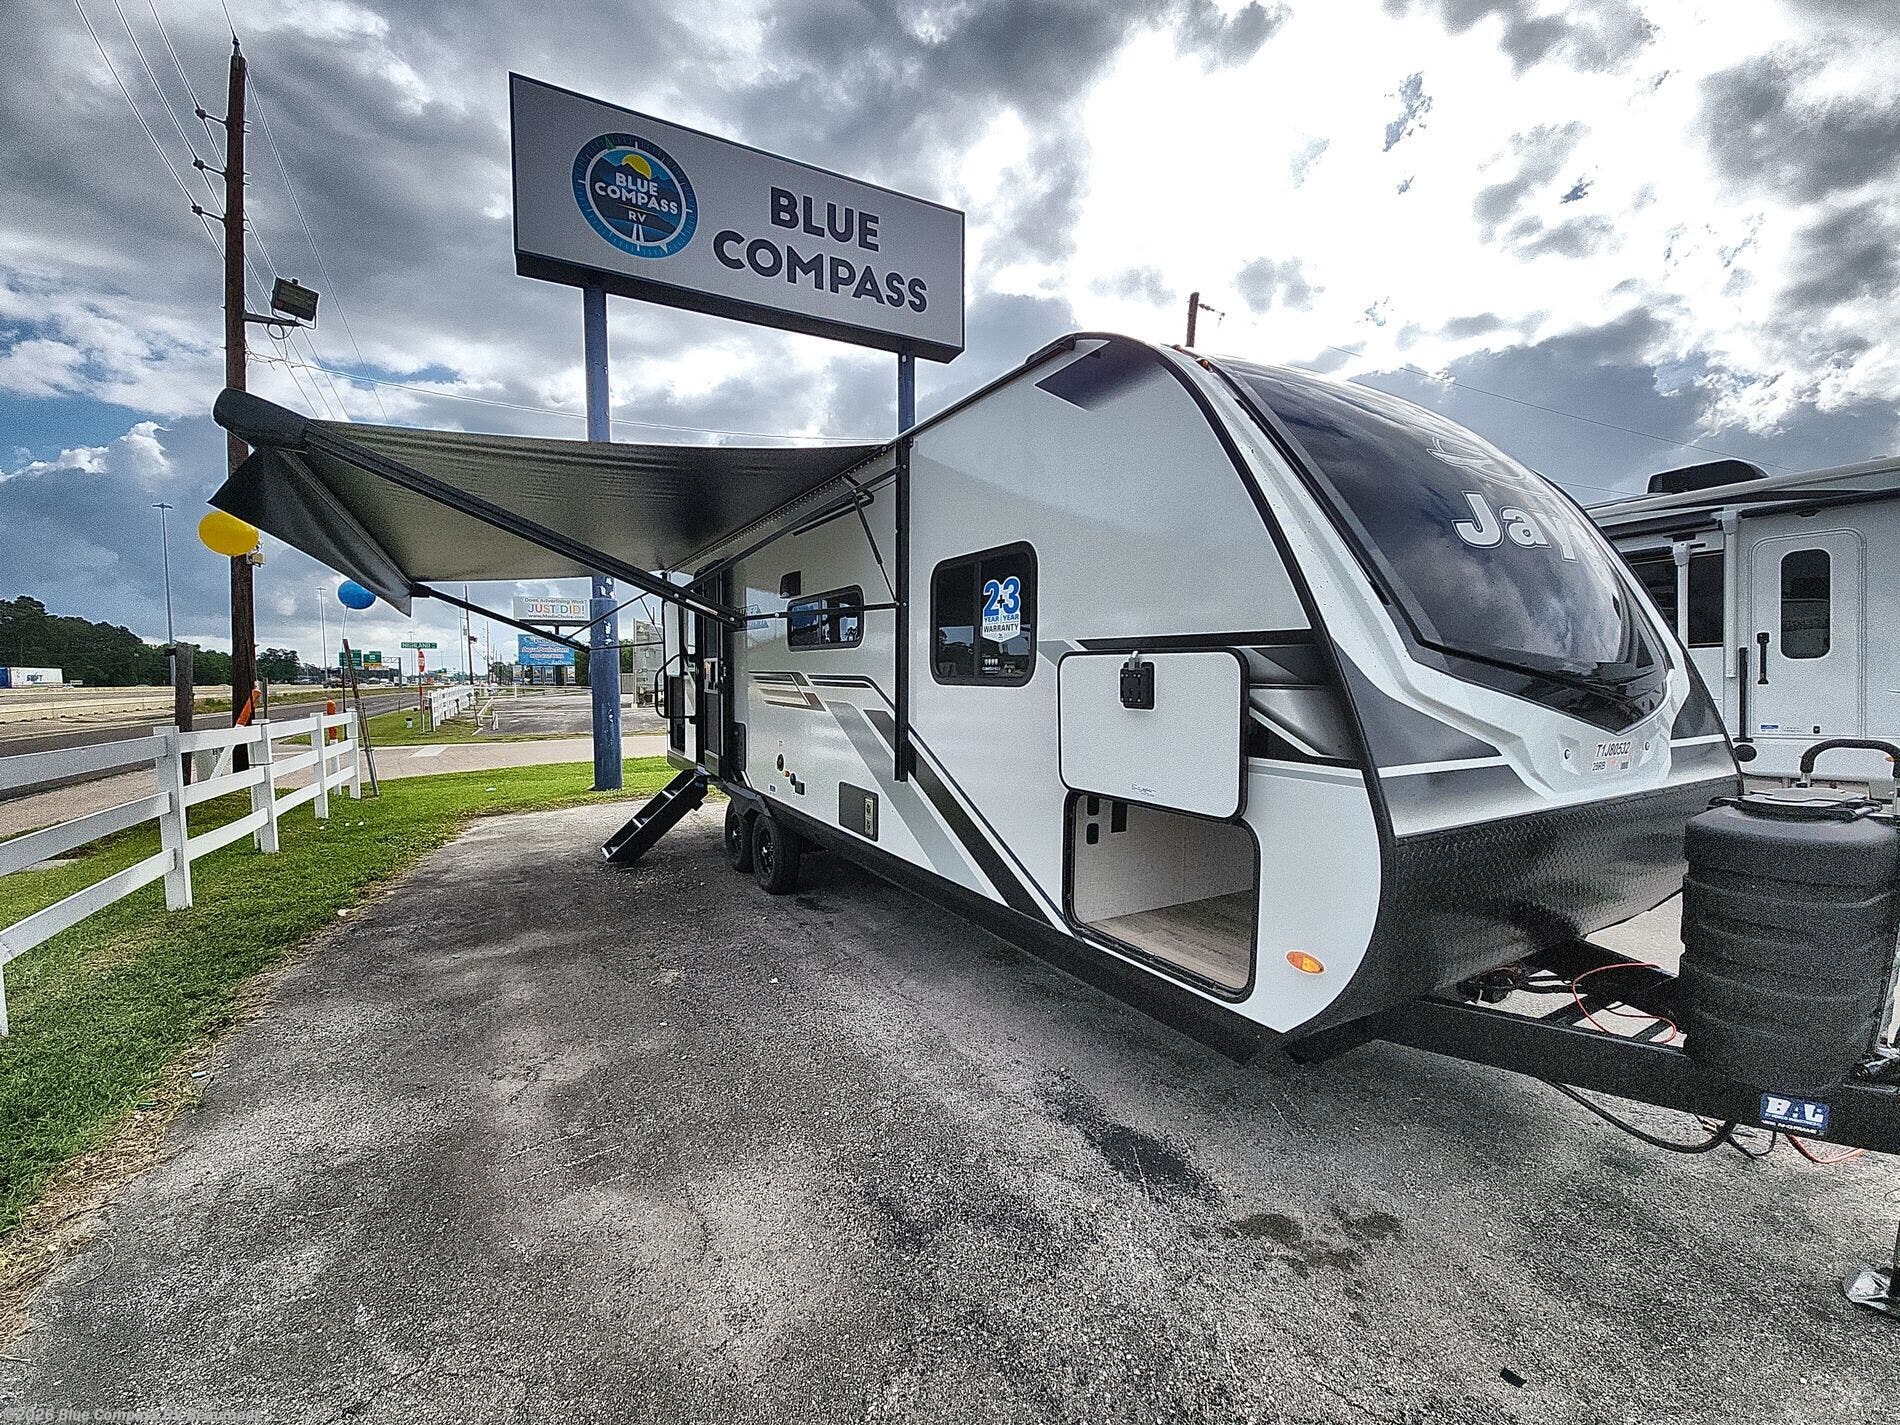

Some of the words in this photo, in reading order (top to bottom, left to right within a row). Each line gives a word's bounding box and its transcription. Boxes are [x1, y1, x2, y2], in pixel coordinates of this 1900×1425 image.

[614, 172, 659, 197] BLUE
[593, 181, 679, 216] COMPASS
[627, 209, 647, 224] RV
[770, 186, 881, 253] BLUE
[712, 229, 928, 314] COMPASS
[528, 604, 556, 613] JUST
[560, 605, 585, 613] DID!
[984, 615, 1000, 624] YEAR
[984, 623, 1020, 633] WARRANTY
